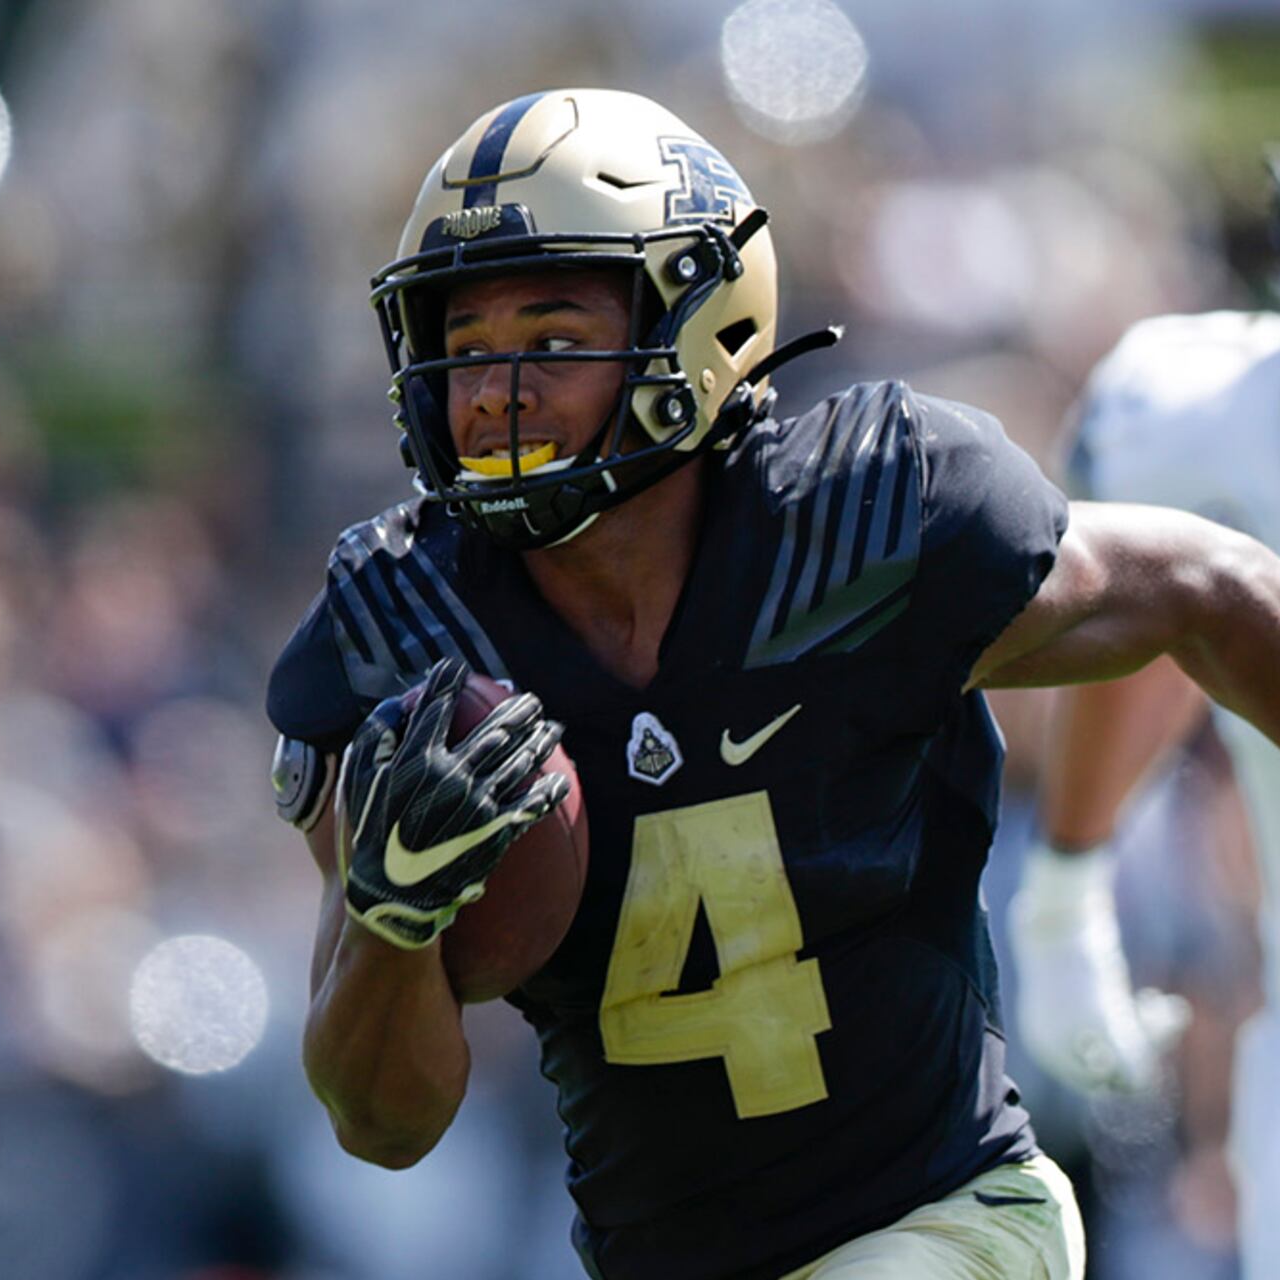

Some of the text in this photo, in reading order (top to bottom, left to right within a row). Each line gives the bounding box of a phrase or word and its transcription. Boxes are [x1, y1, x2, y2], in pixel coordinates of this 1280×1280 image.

[442, 206, 501, 239] PURDUE
[657, 136, 752, 226] P
[599, 789, 832, 1119] 4
